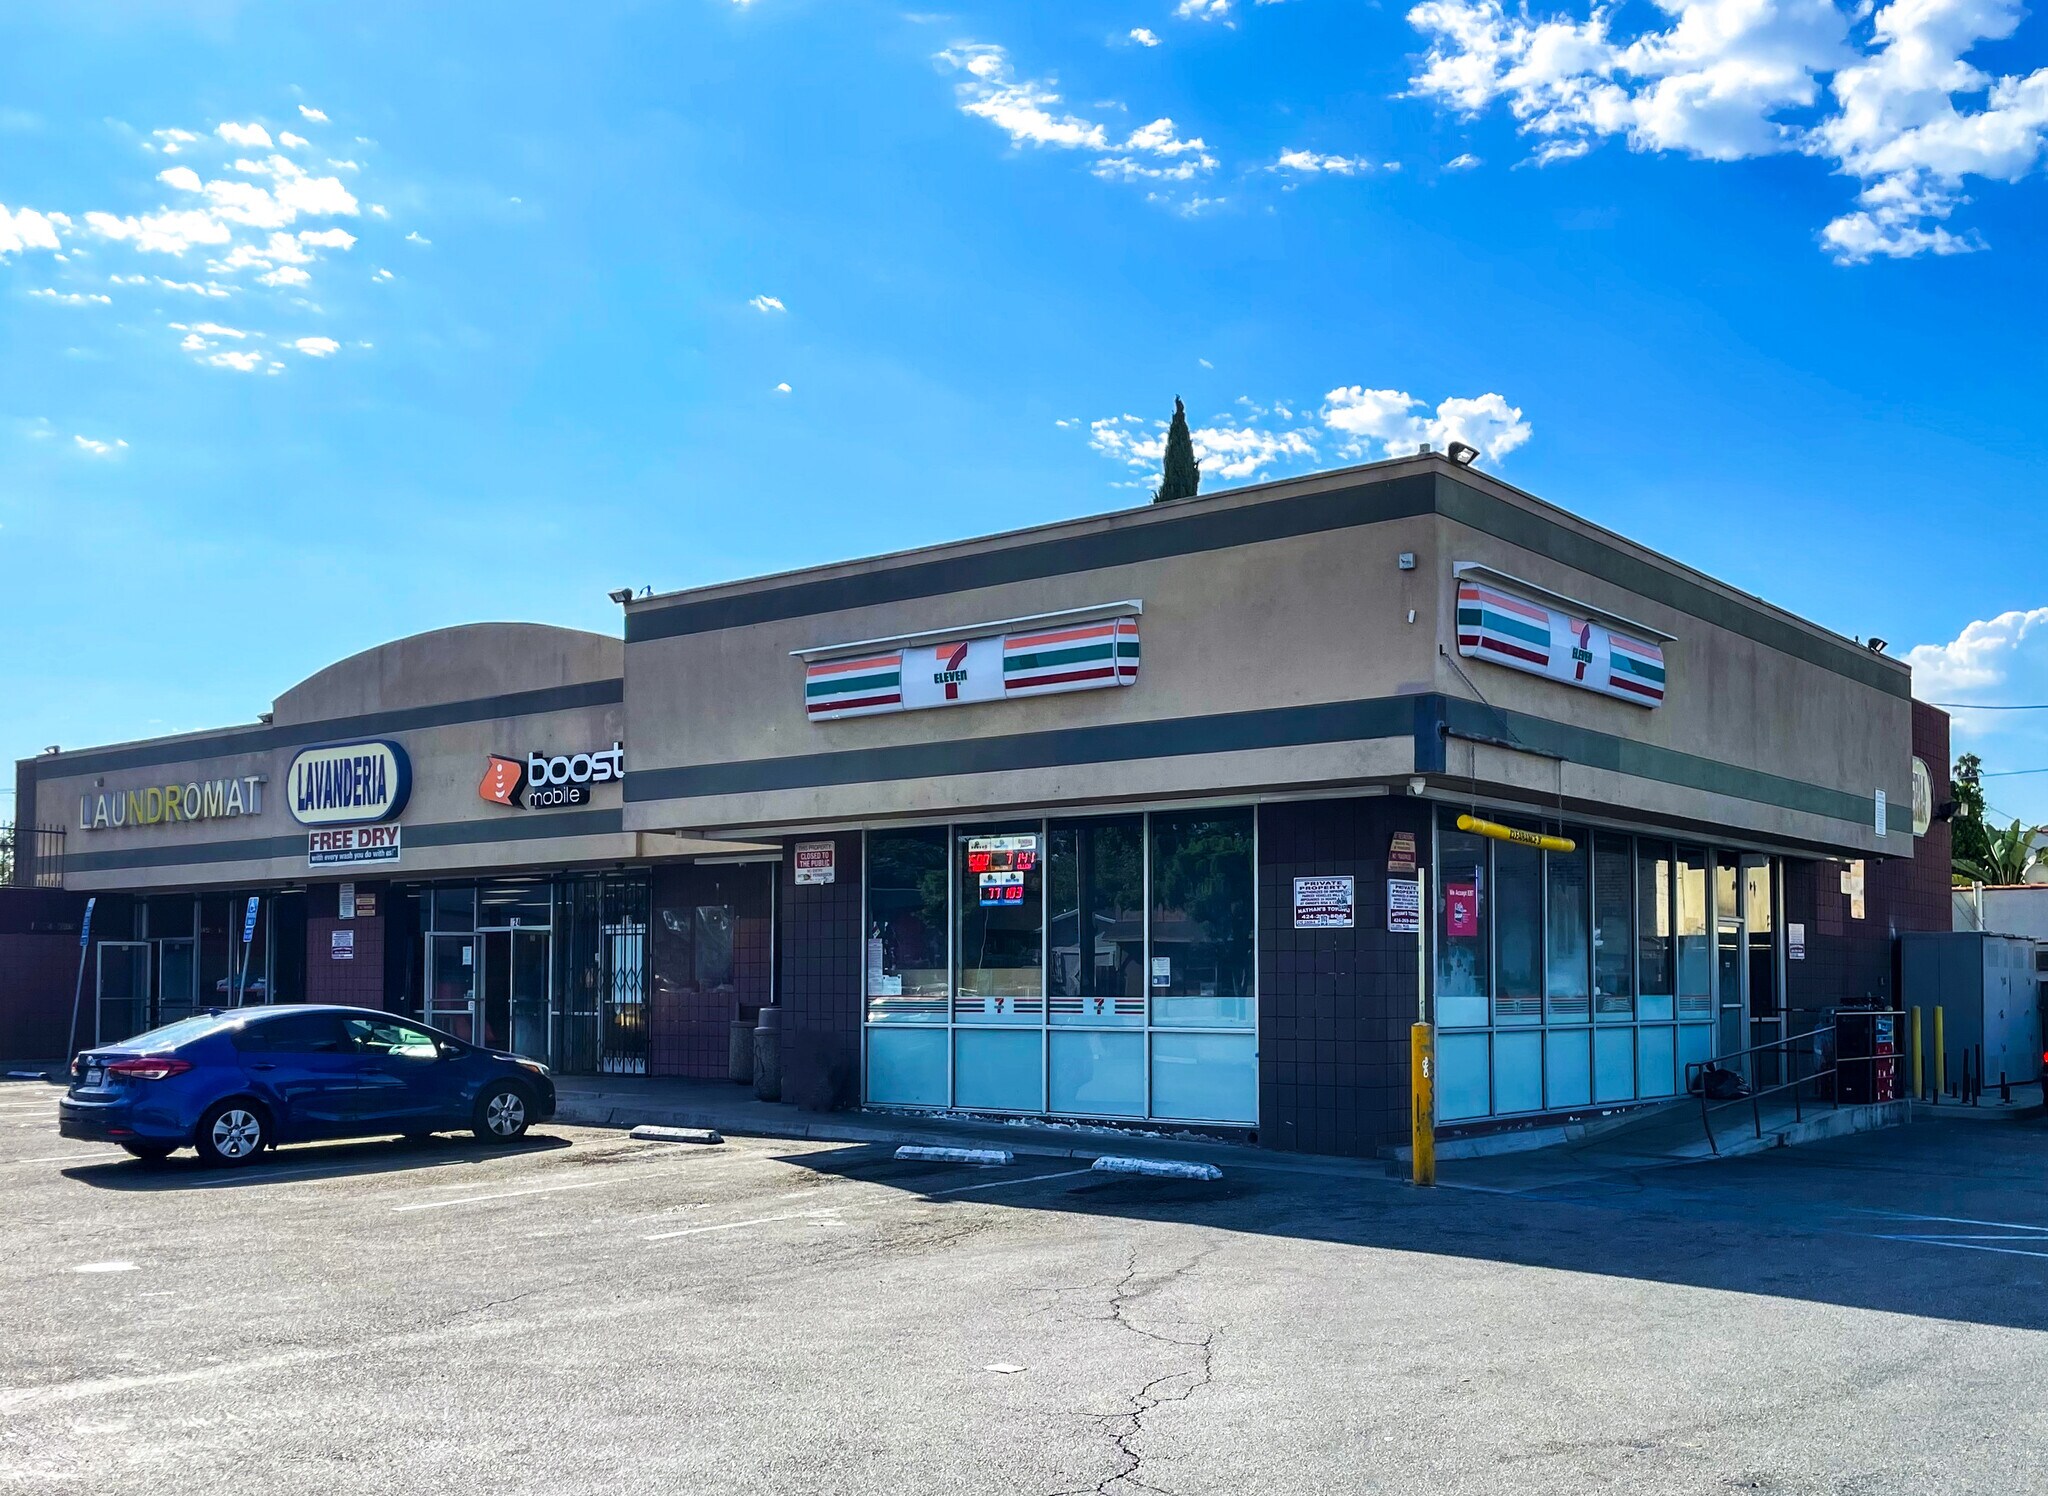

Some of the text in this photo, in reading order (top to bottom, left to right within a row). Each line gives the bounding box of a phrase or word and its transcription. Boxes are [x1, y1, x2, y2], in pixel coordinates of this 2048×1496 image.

[935, 641, 968, 699] 7
[528, 742, 625, 786] boost
[298, 754, 387, 811] LAVANDERIA
[79, 775, 264, 831] LAUNDROMAT
[529, 786, 580, 806] mobile
[310, 826, 399, 851] FREE DRY
[324, 853, 338, 862] every
[354, 852, 364, 860] you
[364, 850, 372, 858] do
[800, 851, 829, 860] CLOSED TO
[800, 859, 830, 868] THE PUBLIC
[988, 887, 1001, 899] 77
[1297, 906, 1327, 914] NATHAN'S
